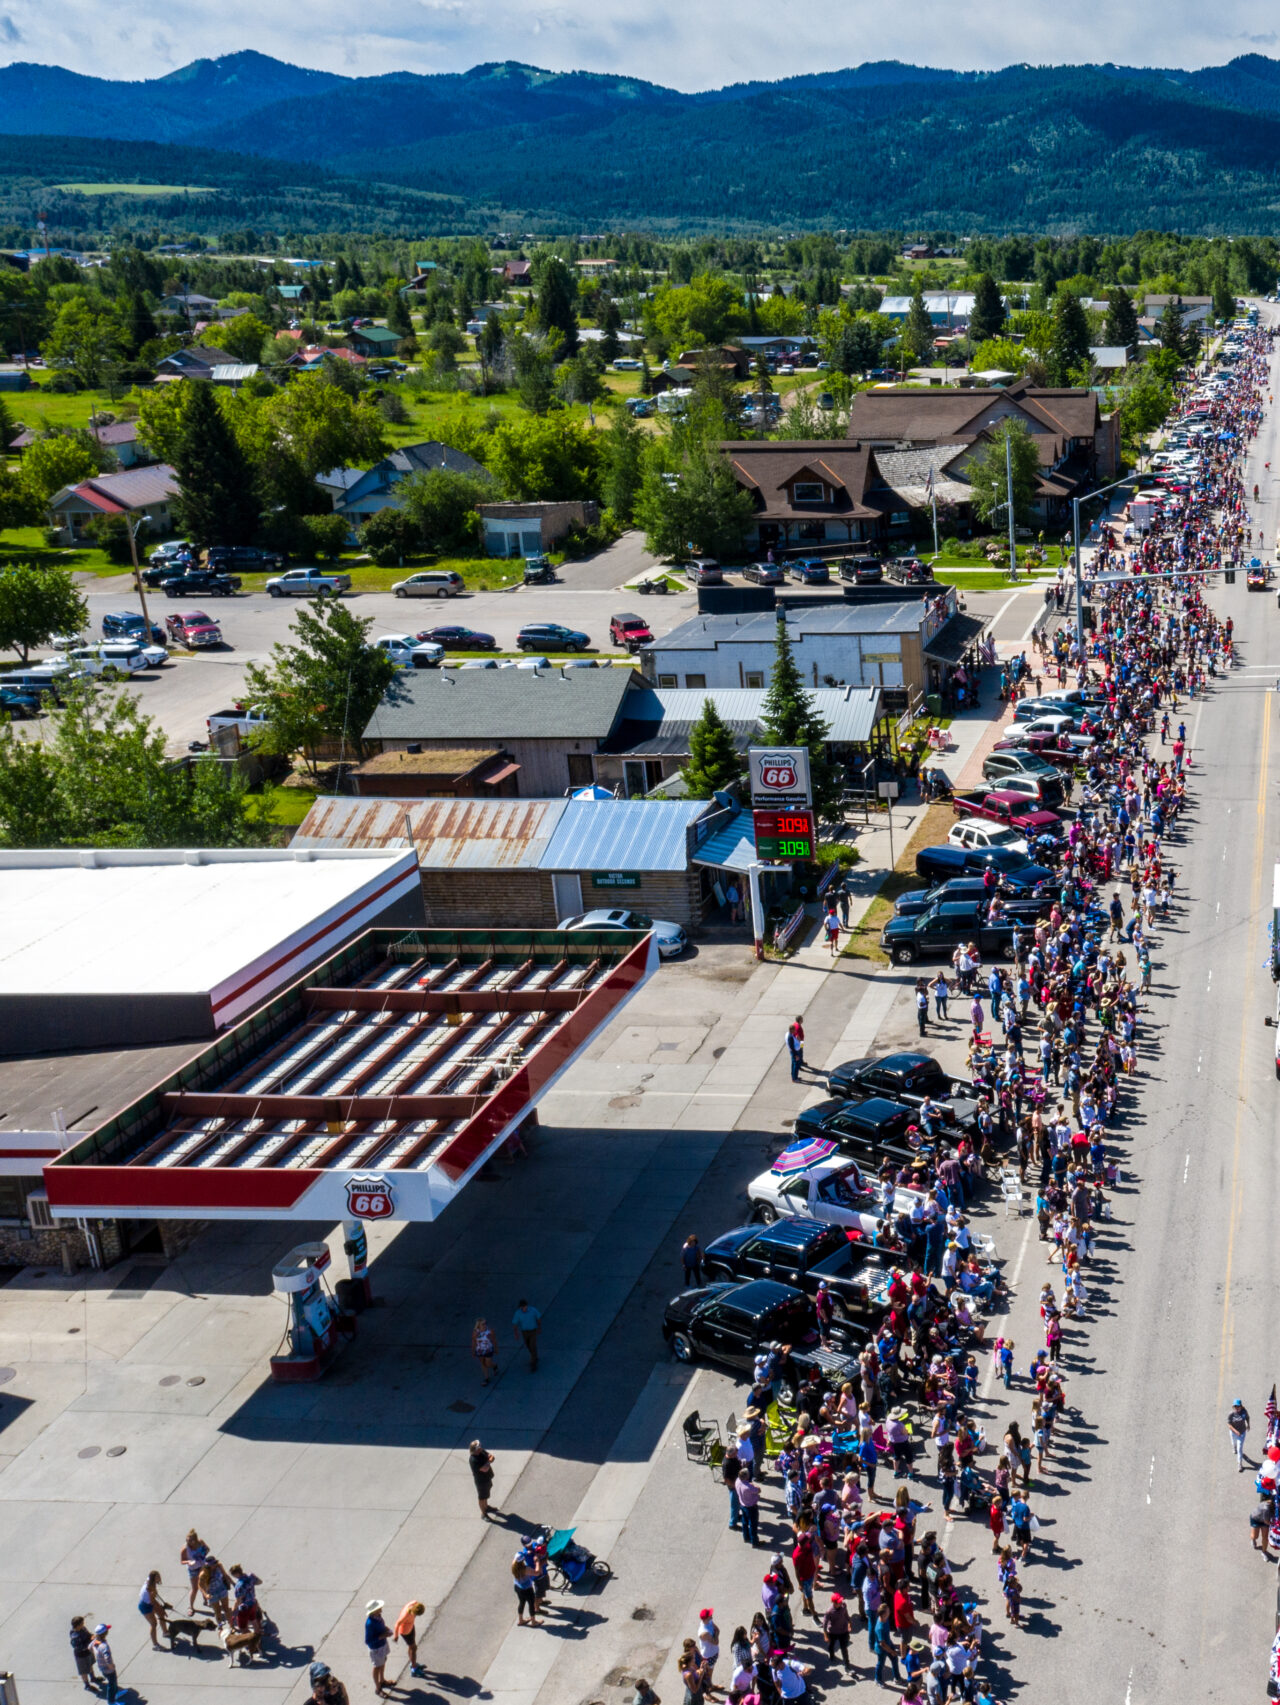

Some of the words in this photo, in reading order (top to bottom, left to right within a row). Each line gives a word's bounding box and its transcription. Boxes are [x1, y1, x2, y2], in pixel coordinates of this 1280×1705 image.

[764, 759, 791, 767] PHILLIPS
[767, 769, 790, 784] 66
[351, 1184, 385, 1193] PHILLIPS
[356, 1195, 384, 1212] 66
